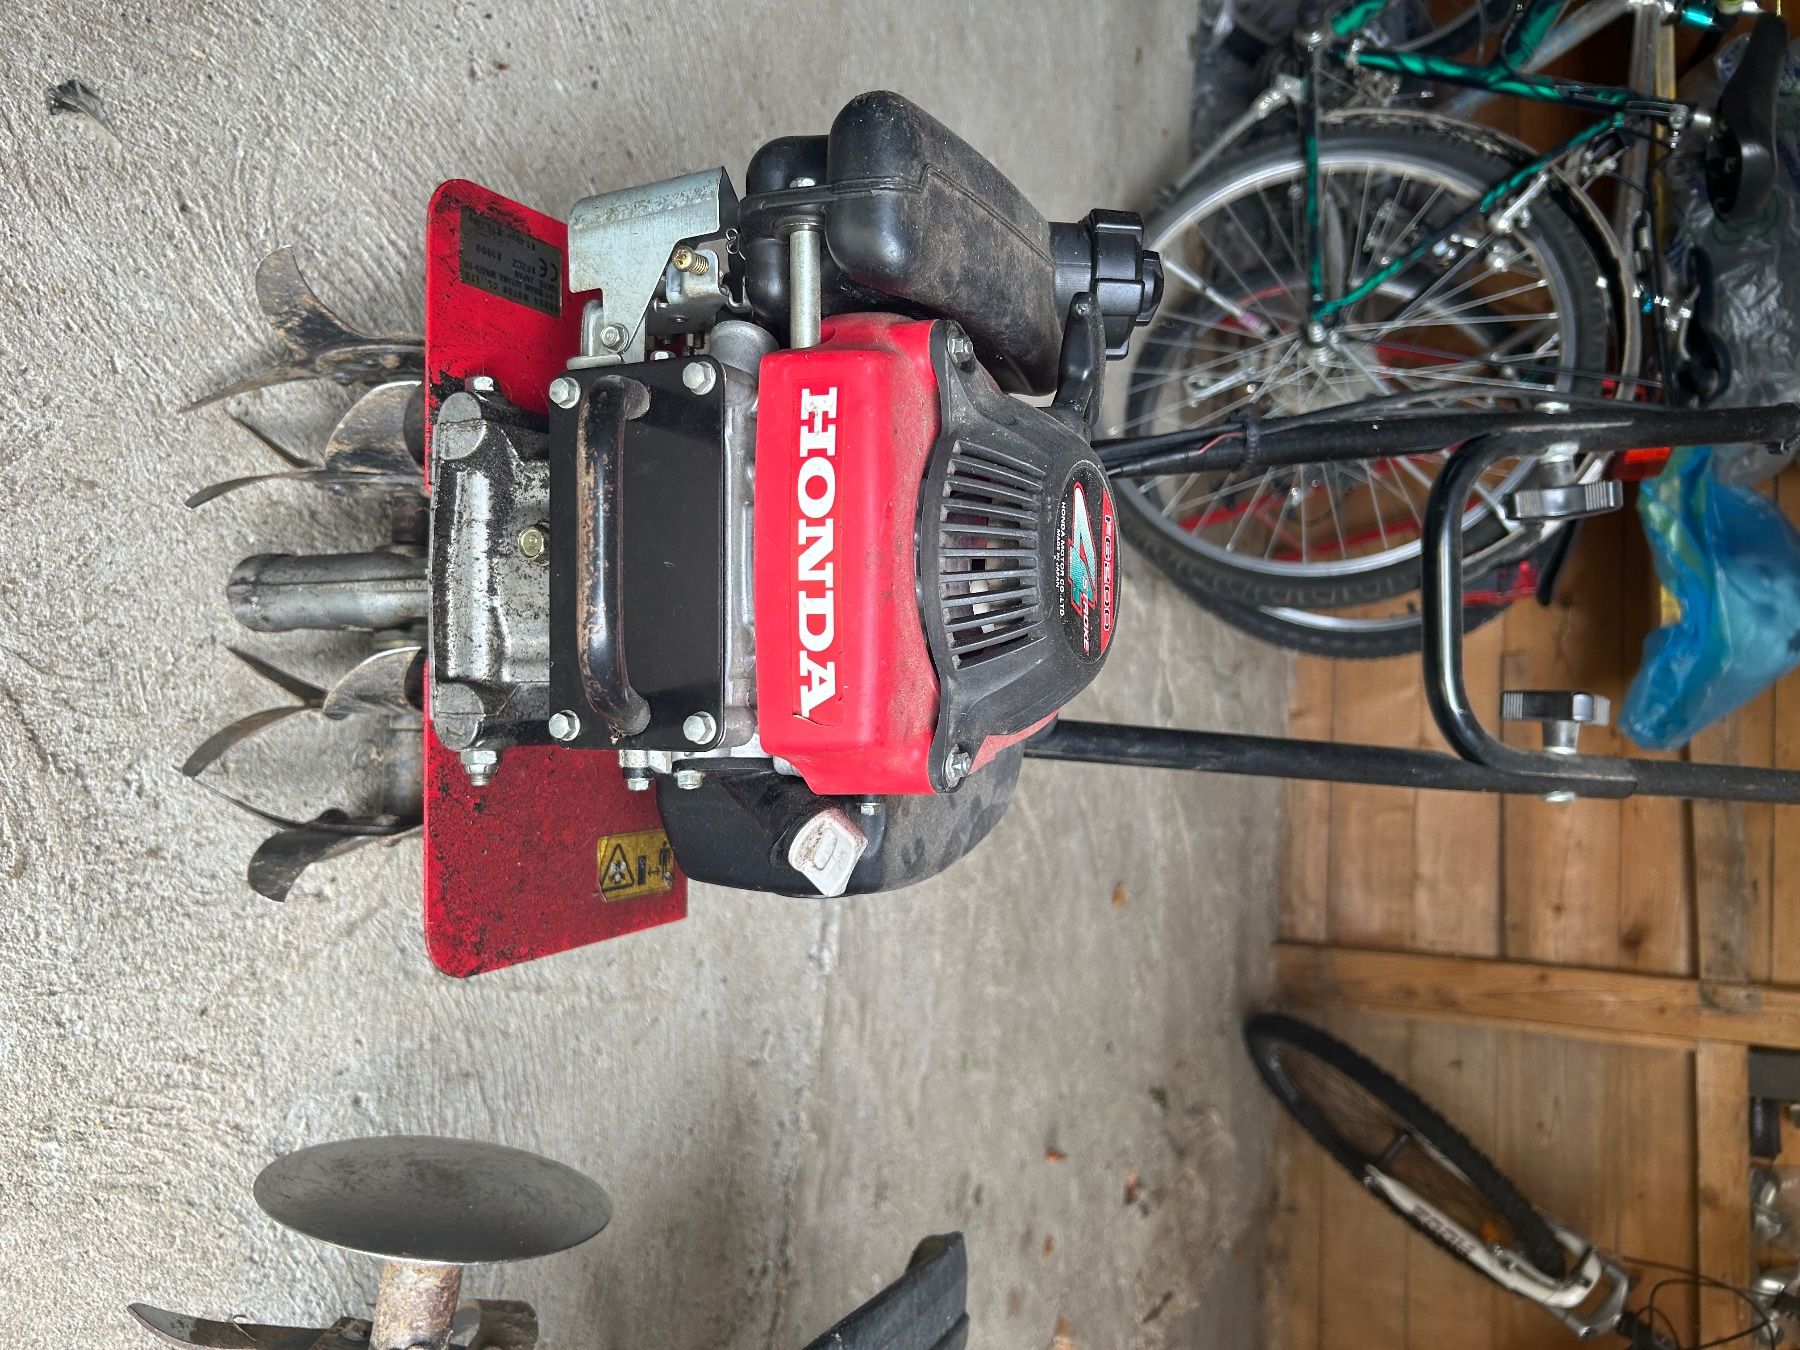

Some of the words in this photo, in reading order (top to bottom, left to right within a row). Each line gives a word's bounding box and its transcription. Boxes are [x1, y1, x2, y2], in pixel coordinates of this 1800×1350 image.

[503, 284, 529, 301] MOTOR
[798, 387, 837, 718] HONDA
[1104, 515, 1112, 632] FG200
